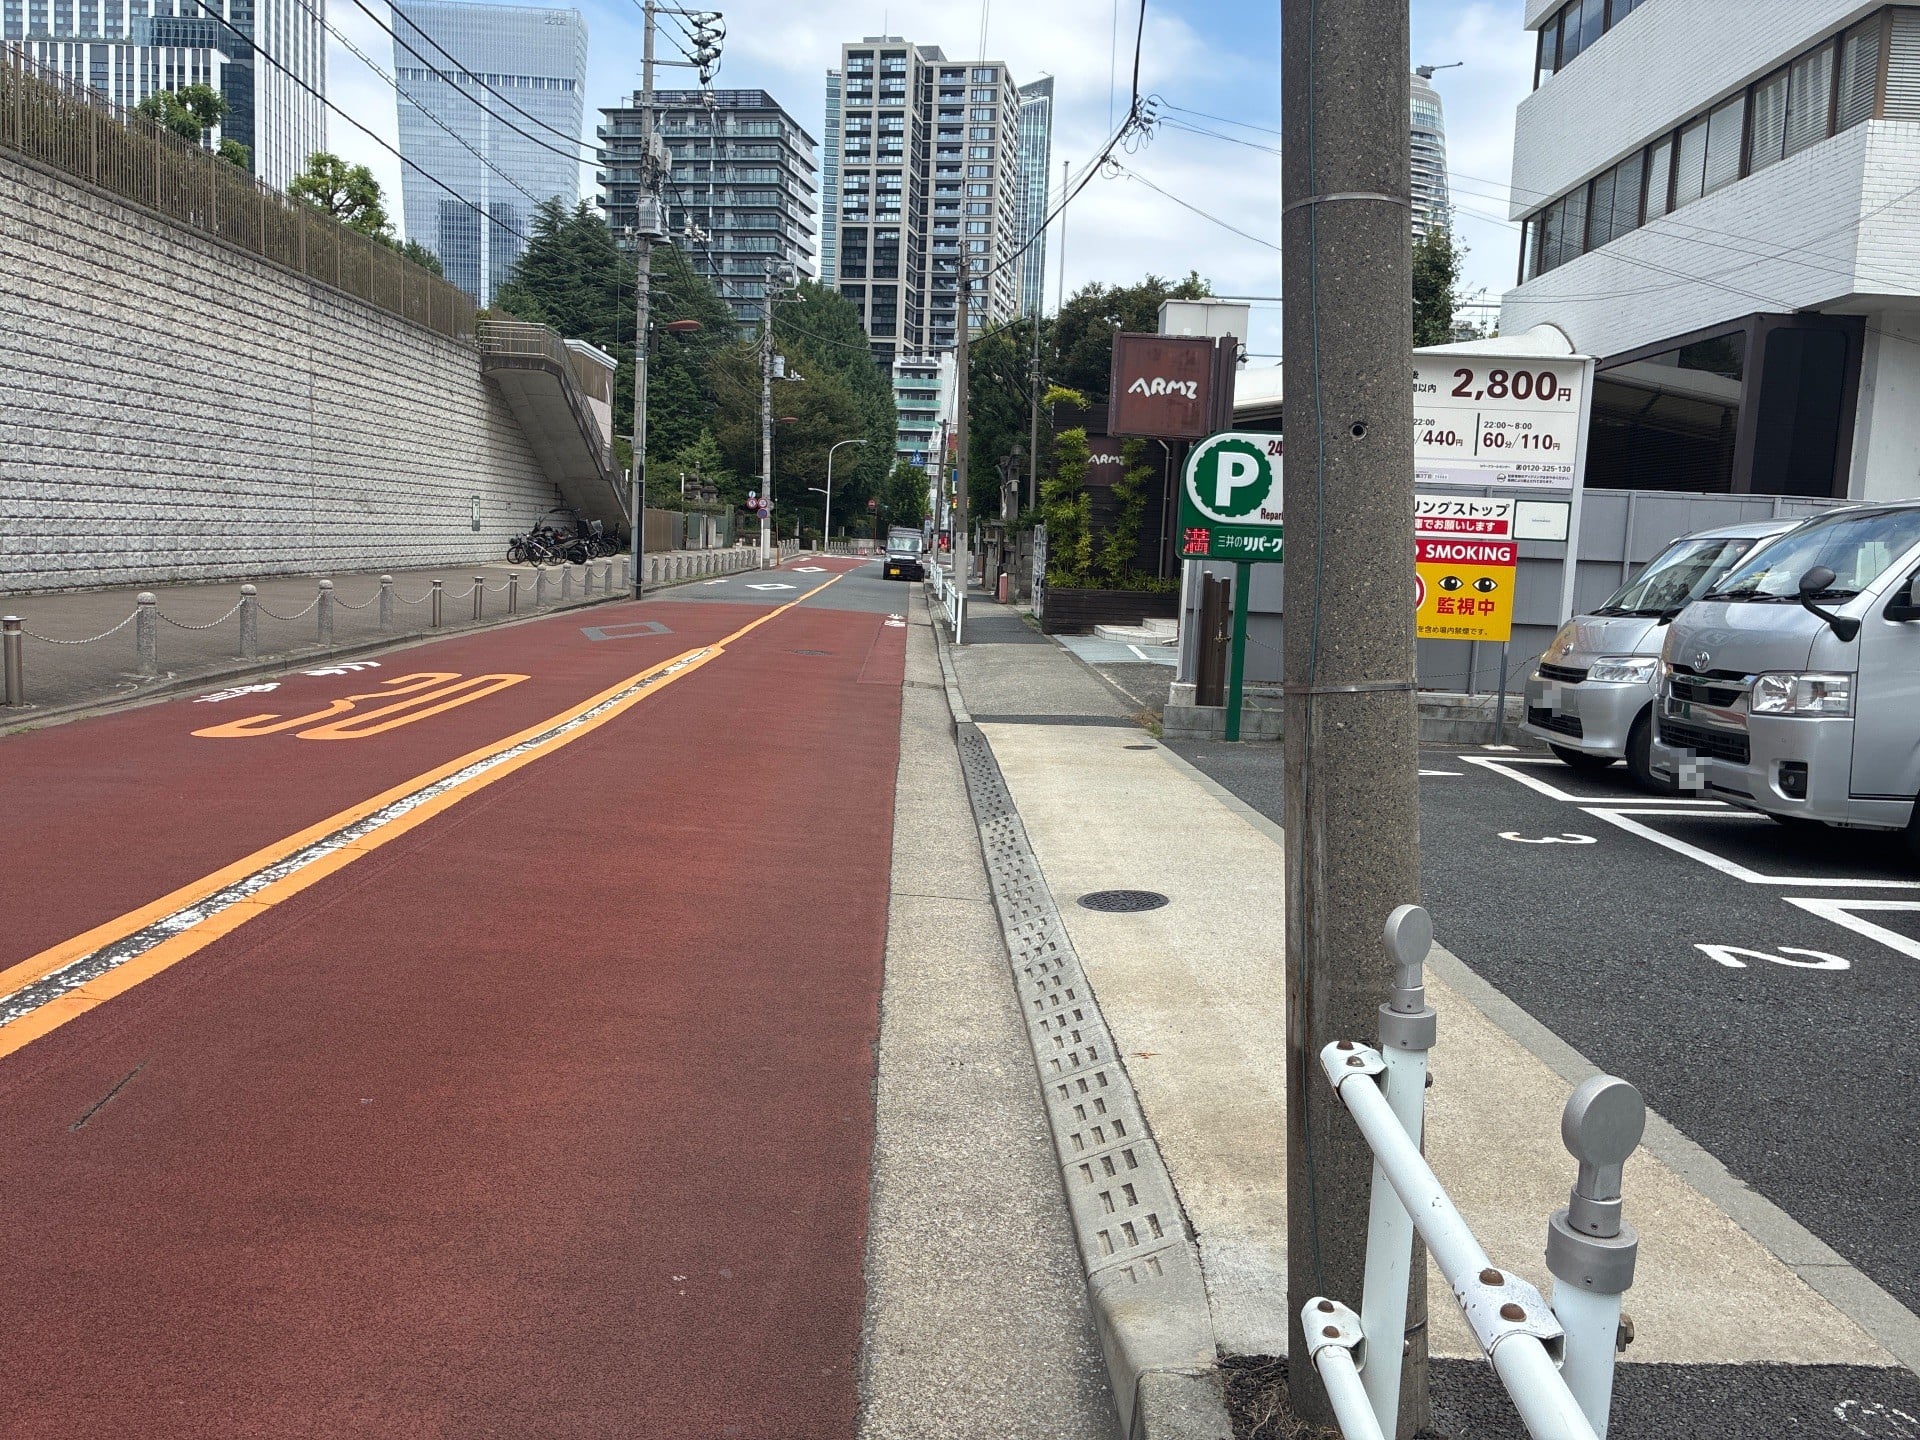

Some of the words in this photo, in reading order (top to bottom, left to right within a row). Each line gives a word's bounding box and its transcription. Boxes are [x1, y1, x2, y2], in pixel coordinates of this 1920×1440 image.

[1128, 377, 1198, 400] ARMZ
[1452, 368, 1571, 402] 2,800円
[1215, 451, 1260, 507] P
[1522, 464, 1571, 473] 0120-325-130
[1260, 507, 1284, 522] Repar
[1183, 528, 1210, 555] 満
[1217, 534, 1284, 552] 三井のリパーク
[1425, 544, 1511, 562] SMOKING
[1436, 597, 1496, 616] 監視中
[190, 672, 532, 740] 30
[1497, 830, 1598, 846] 3
[1693, 942, 1851, 971] 2
